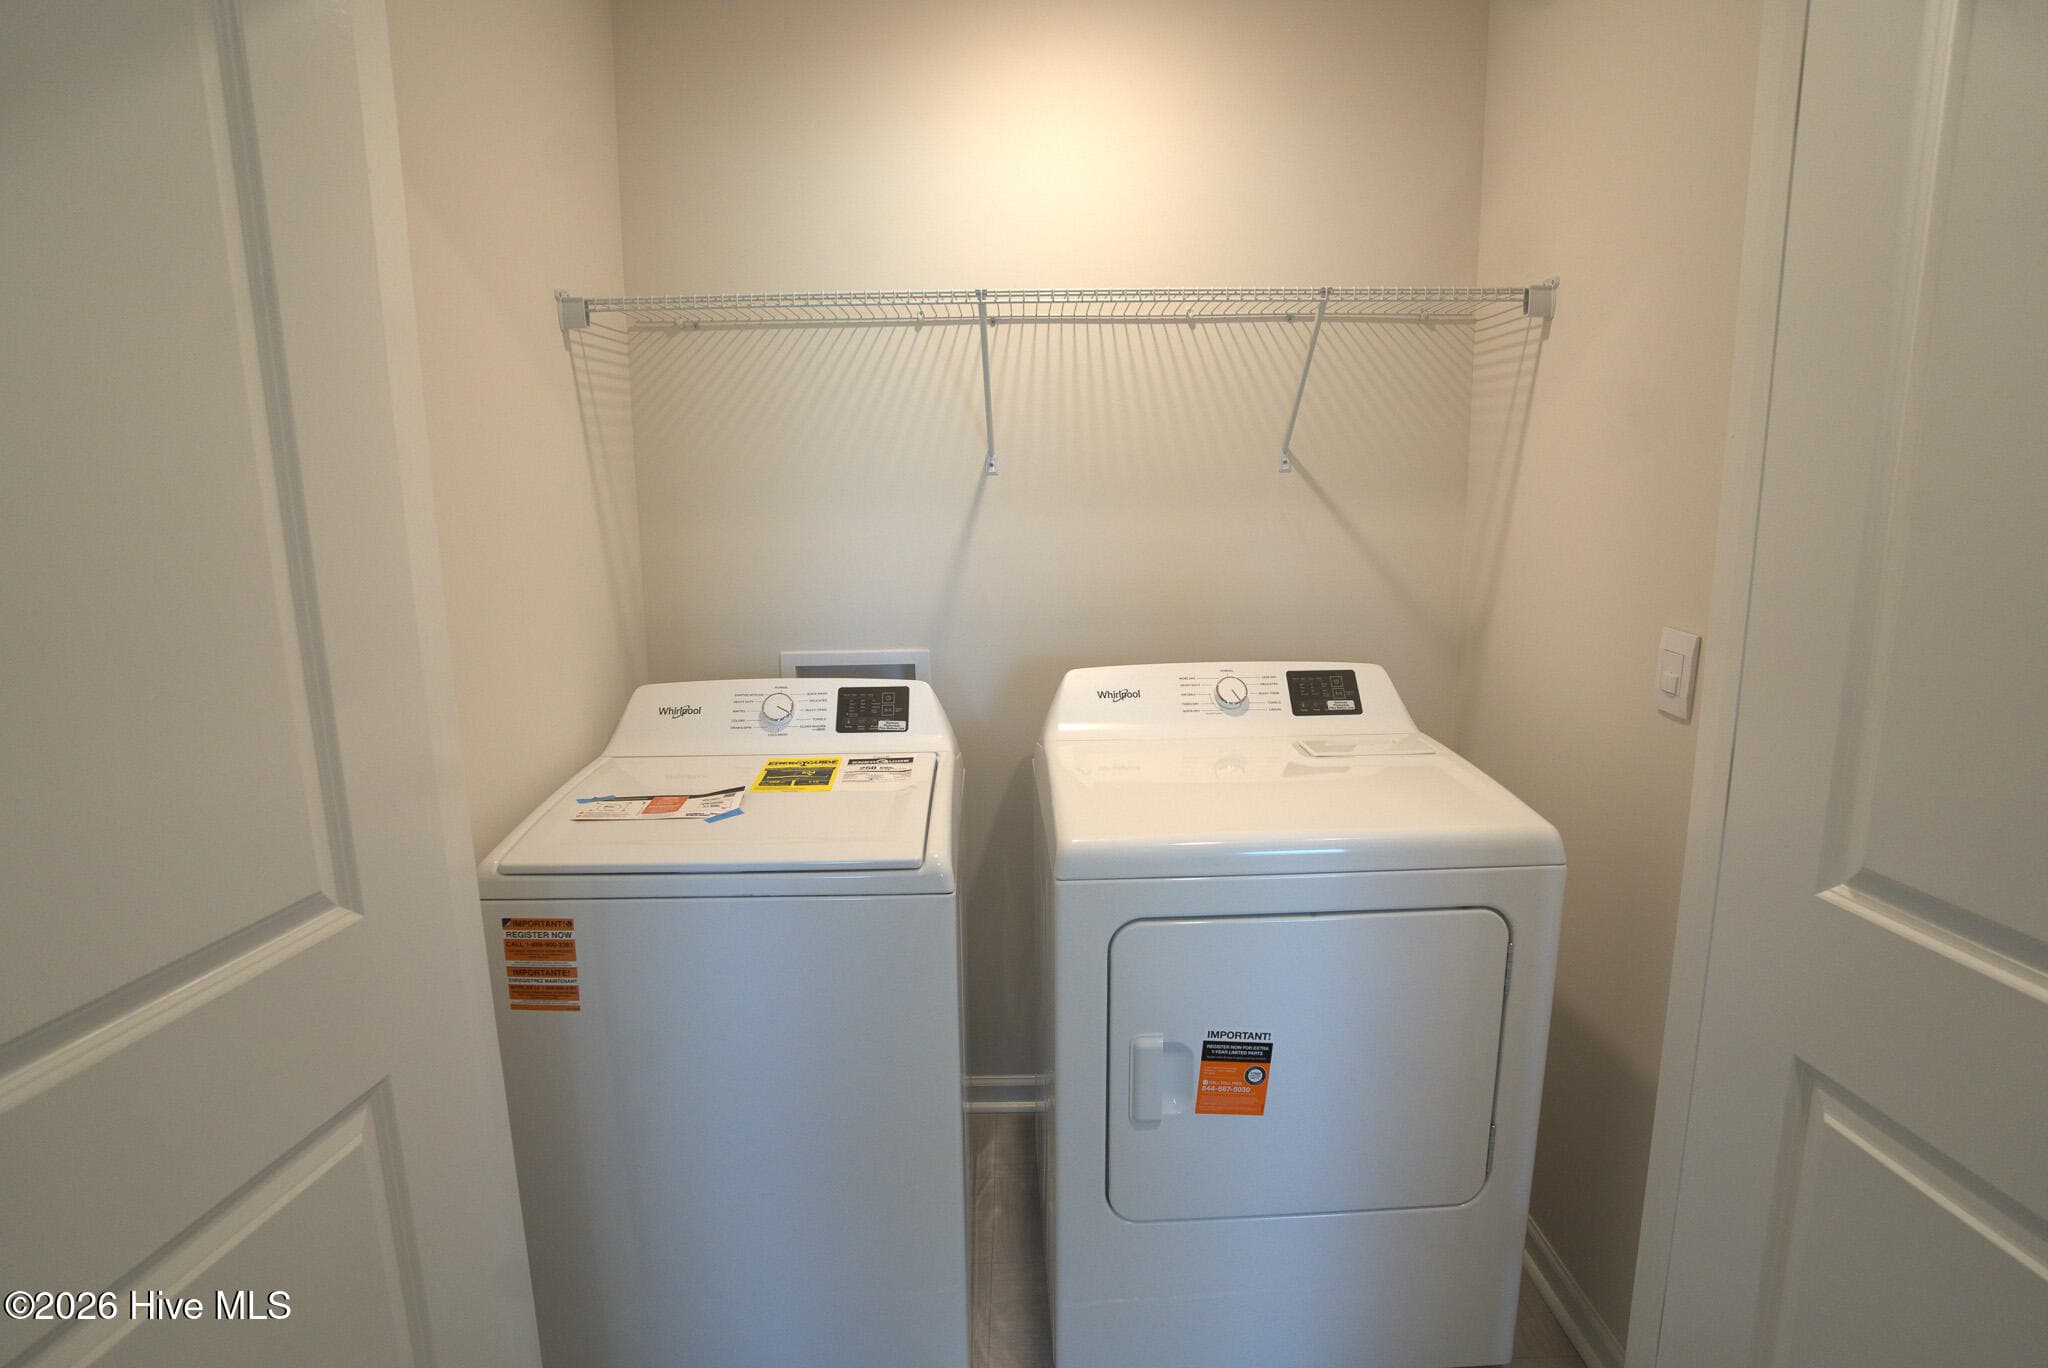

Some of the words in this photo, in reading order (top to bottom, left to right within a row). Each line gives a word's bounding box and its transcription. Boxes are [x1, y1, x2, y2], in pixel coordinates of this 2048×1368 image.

[1096, 688, 1141, 703] Whirlpool
[658, 704, 702, 719] Whirlpool
[512, 920, 565, 928] IMPORTANT!
[505, 931, 550, 939] REGISTER
[551, 931, 573, 939] NOW
[1207, 1030, 1272, 1041] IMPORTANT!
